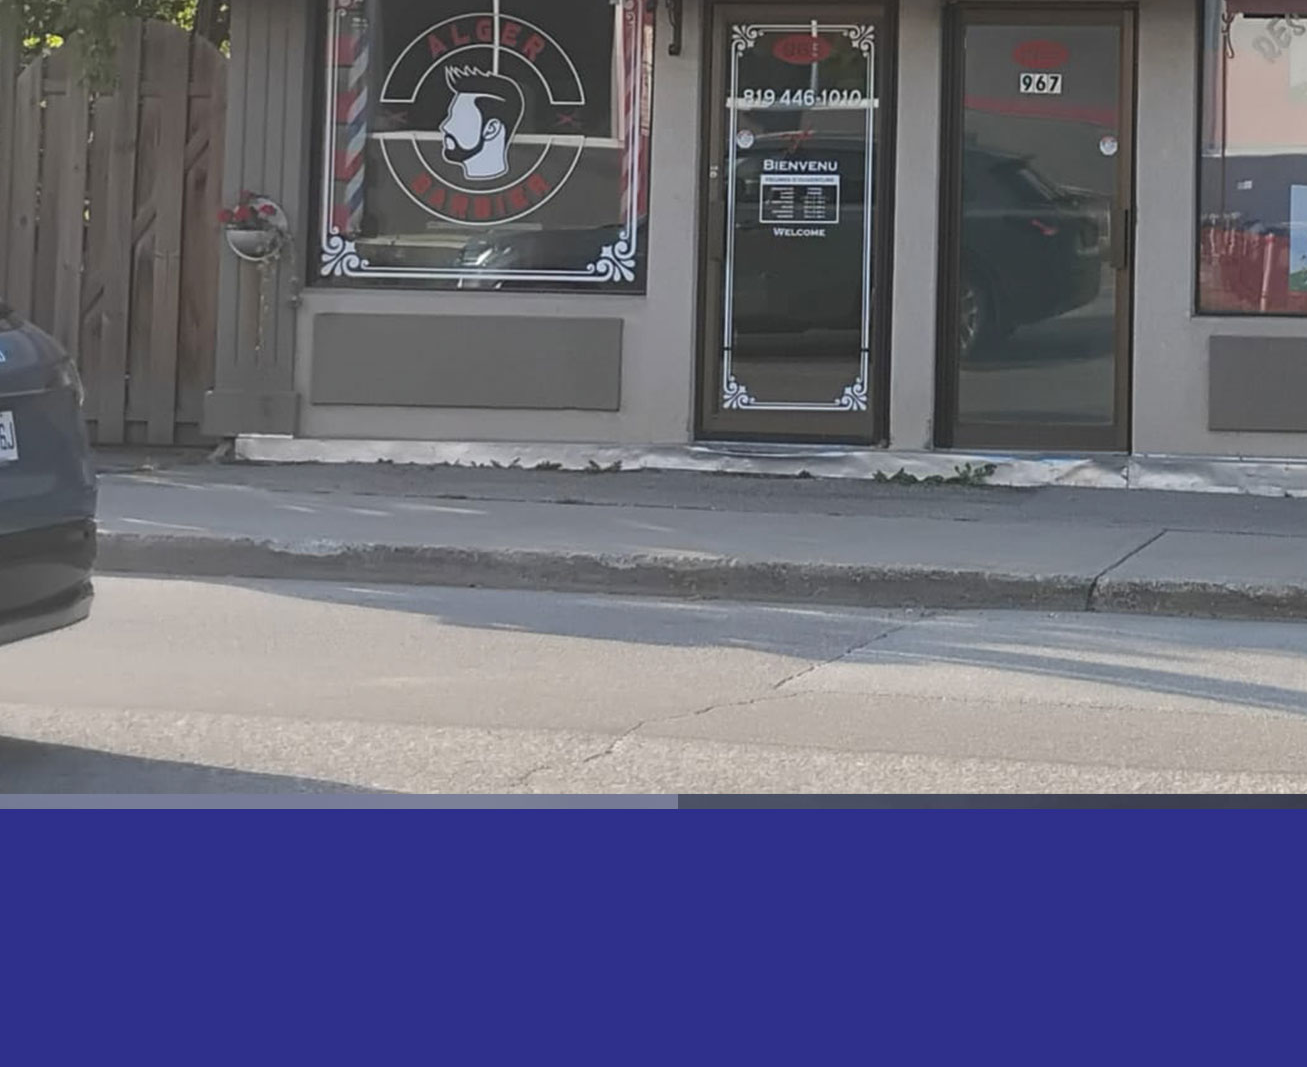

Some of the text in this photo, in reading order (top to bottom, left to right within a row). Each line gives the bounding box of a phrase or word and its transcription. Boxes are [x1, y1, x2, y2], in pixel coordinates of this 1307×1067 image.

[427, 18, 546, 62] ALGER
[1022, 74, 1060, 92] 967
[743, 88, 861, 107] 819 446-1010
